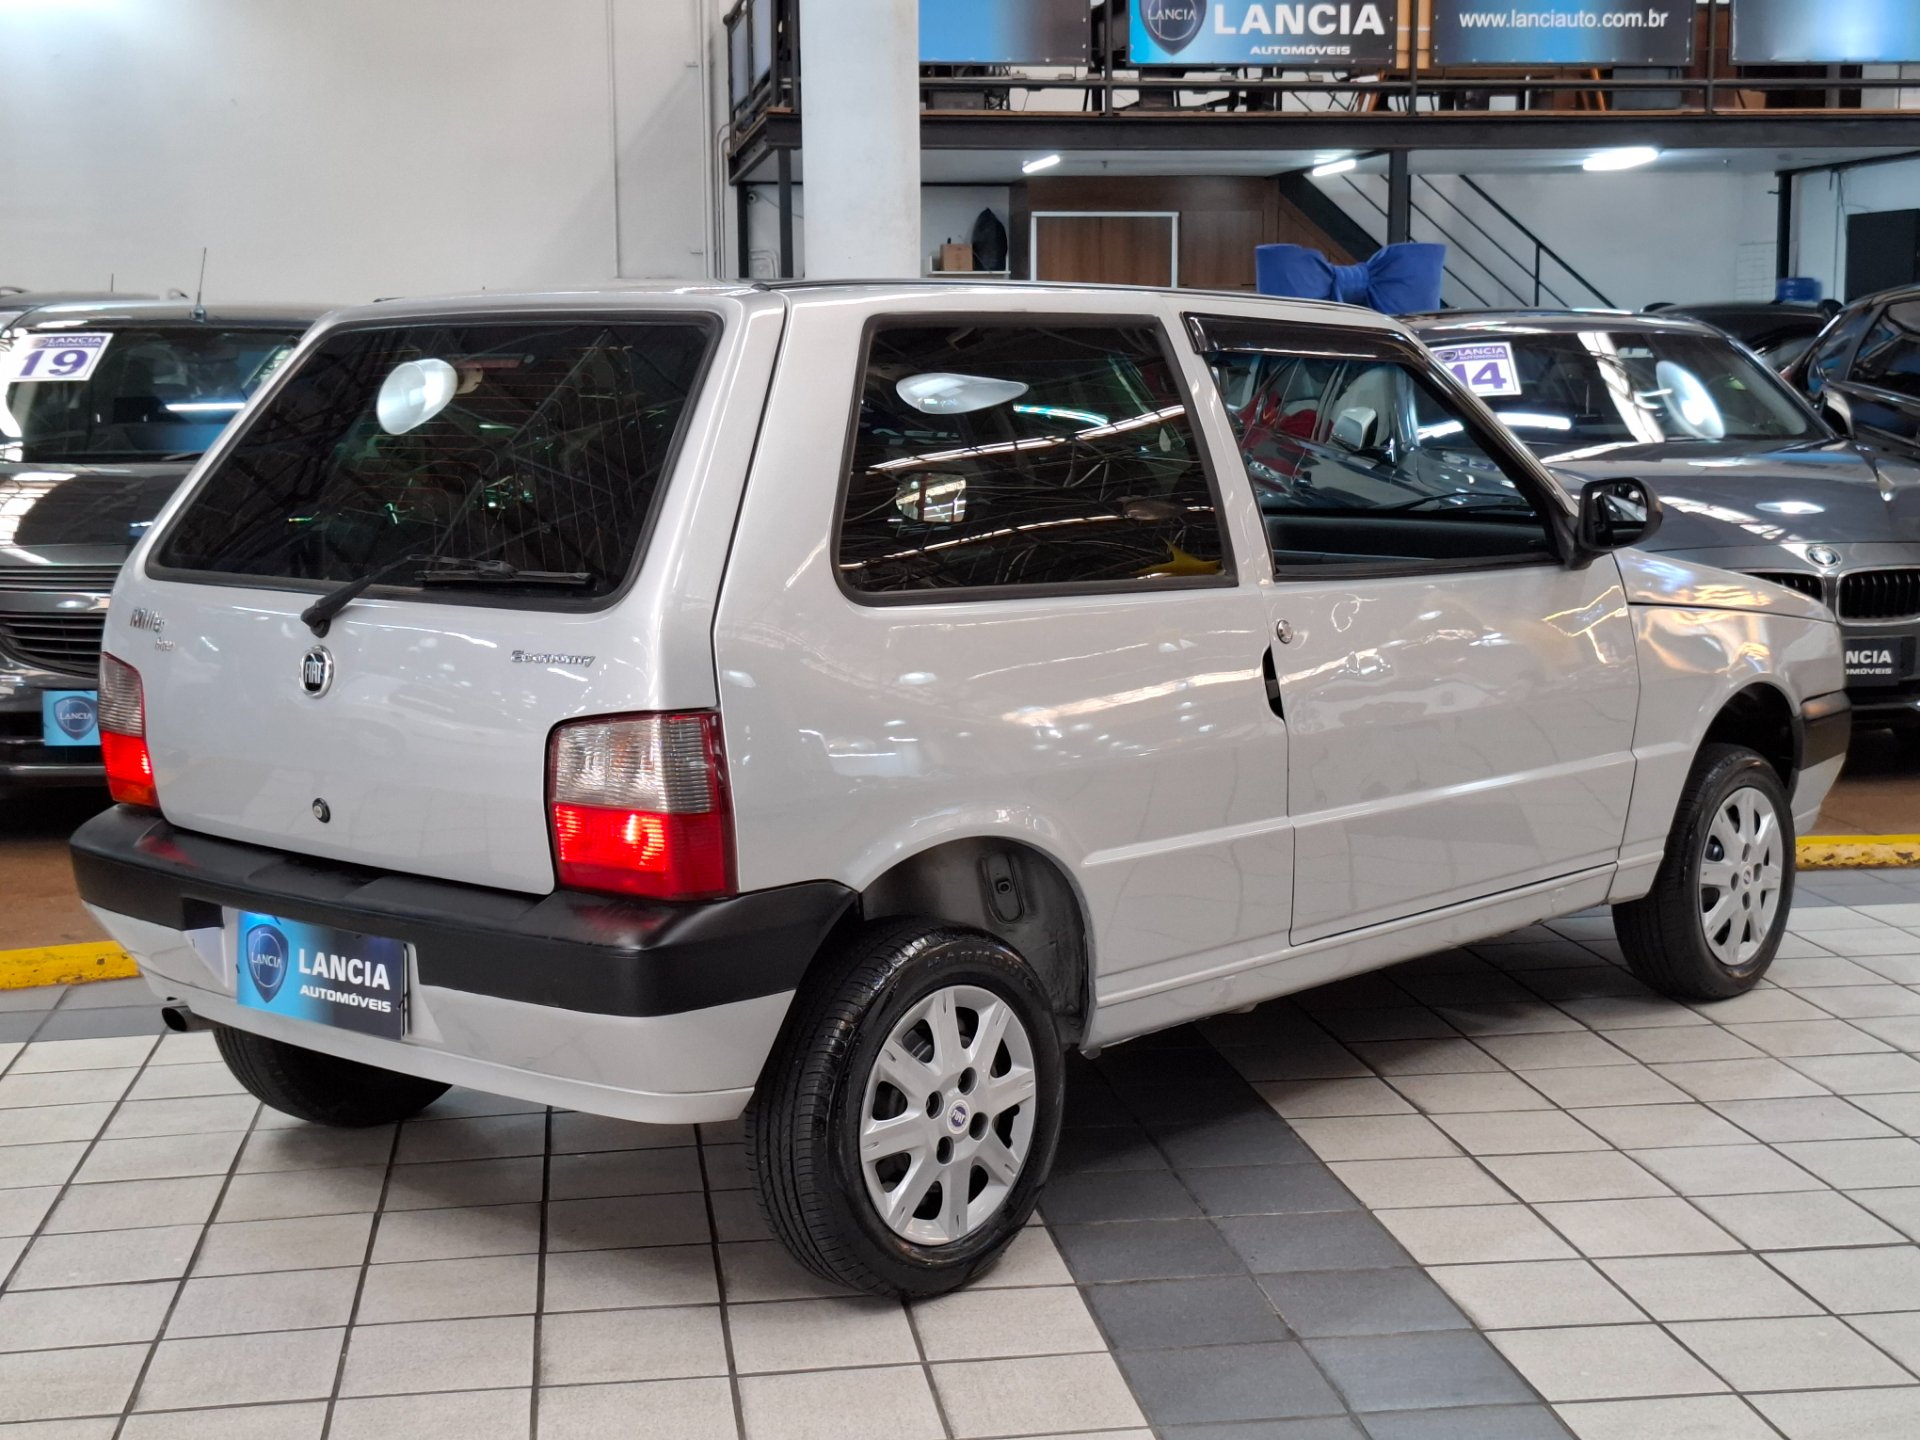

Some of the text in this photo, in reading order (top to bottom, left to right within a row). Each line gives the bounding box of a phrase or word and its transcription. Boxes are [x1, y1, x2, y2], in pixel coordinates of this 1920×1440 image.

[1147, 8, 1197, 21] LANCIA
[1214, 3, 1386, 36] LANCIA
[1459, 9, 1669, 28] www.lanciauto.com.br
[1250, 43, 1350, 56] AUTOMÓVEIS
[49, 336, 103, 344] LANCIA
[1458, 347, 1505, 356] LANCIA
[20, 349, 89, 377] 19
[1845, 650, 1892, 664] NCIA
[304, 660, 324, 684] FIAT
[59, 712, 93, 720] LANCIA
[251, 951, 283, 969] LANCIA
[298, 948, 391, 991] LANCIA
[300, 984, 392, 1014] AUTOMÓVEIS
